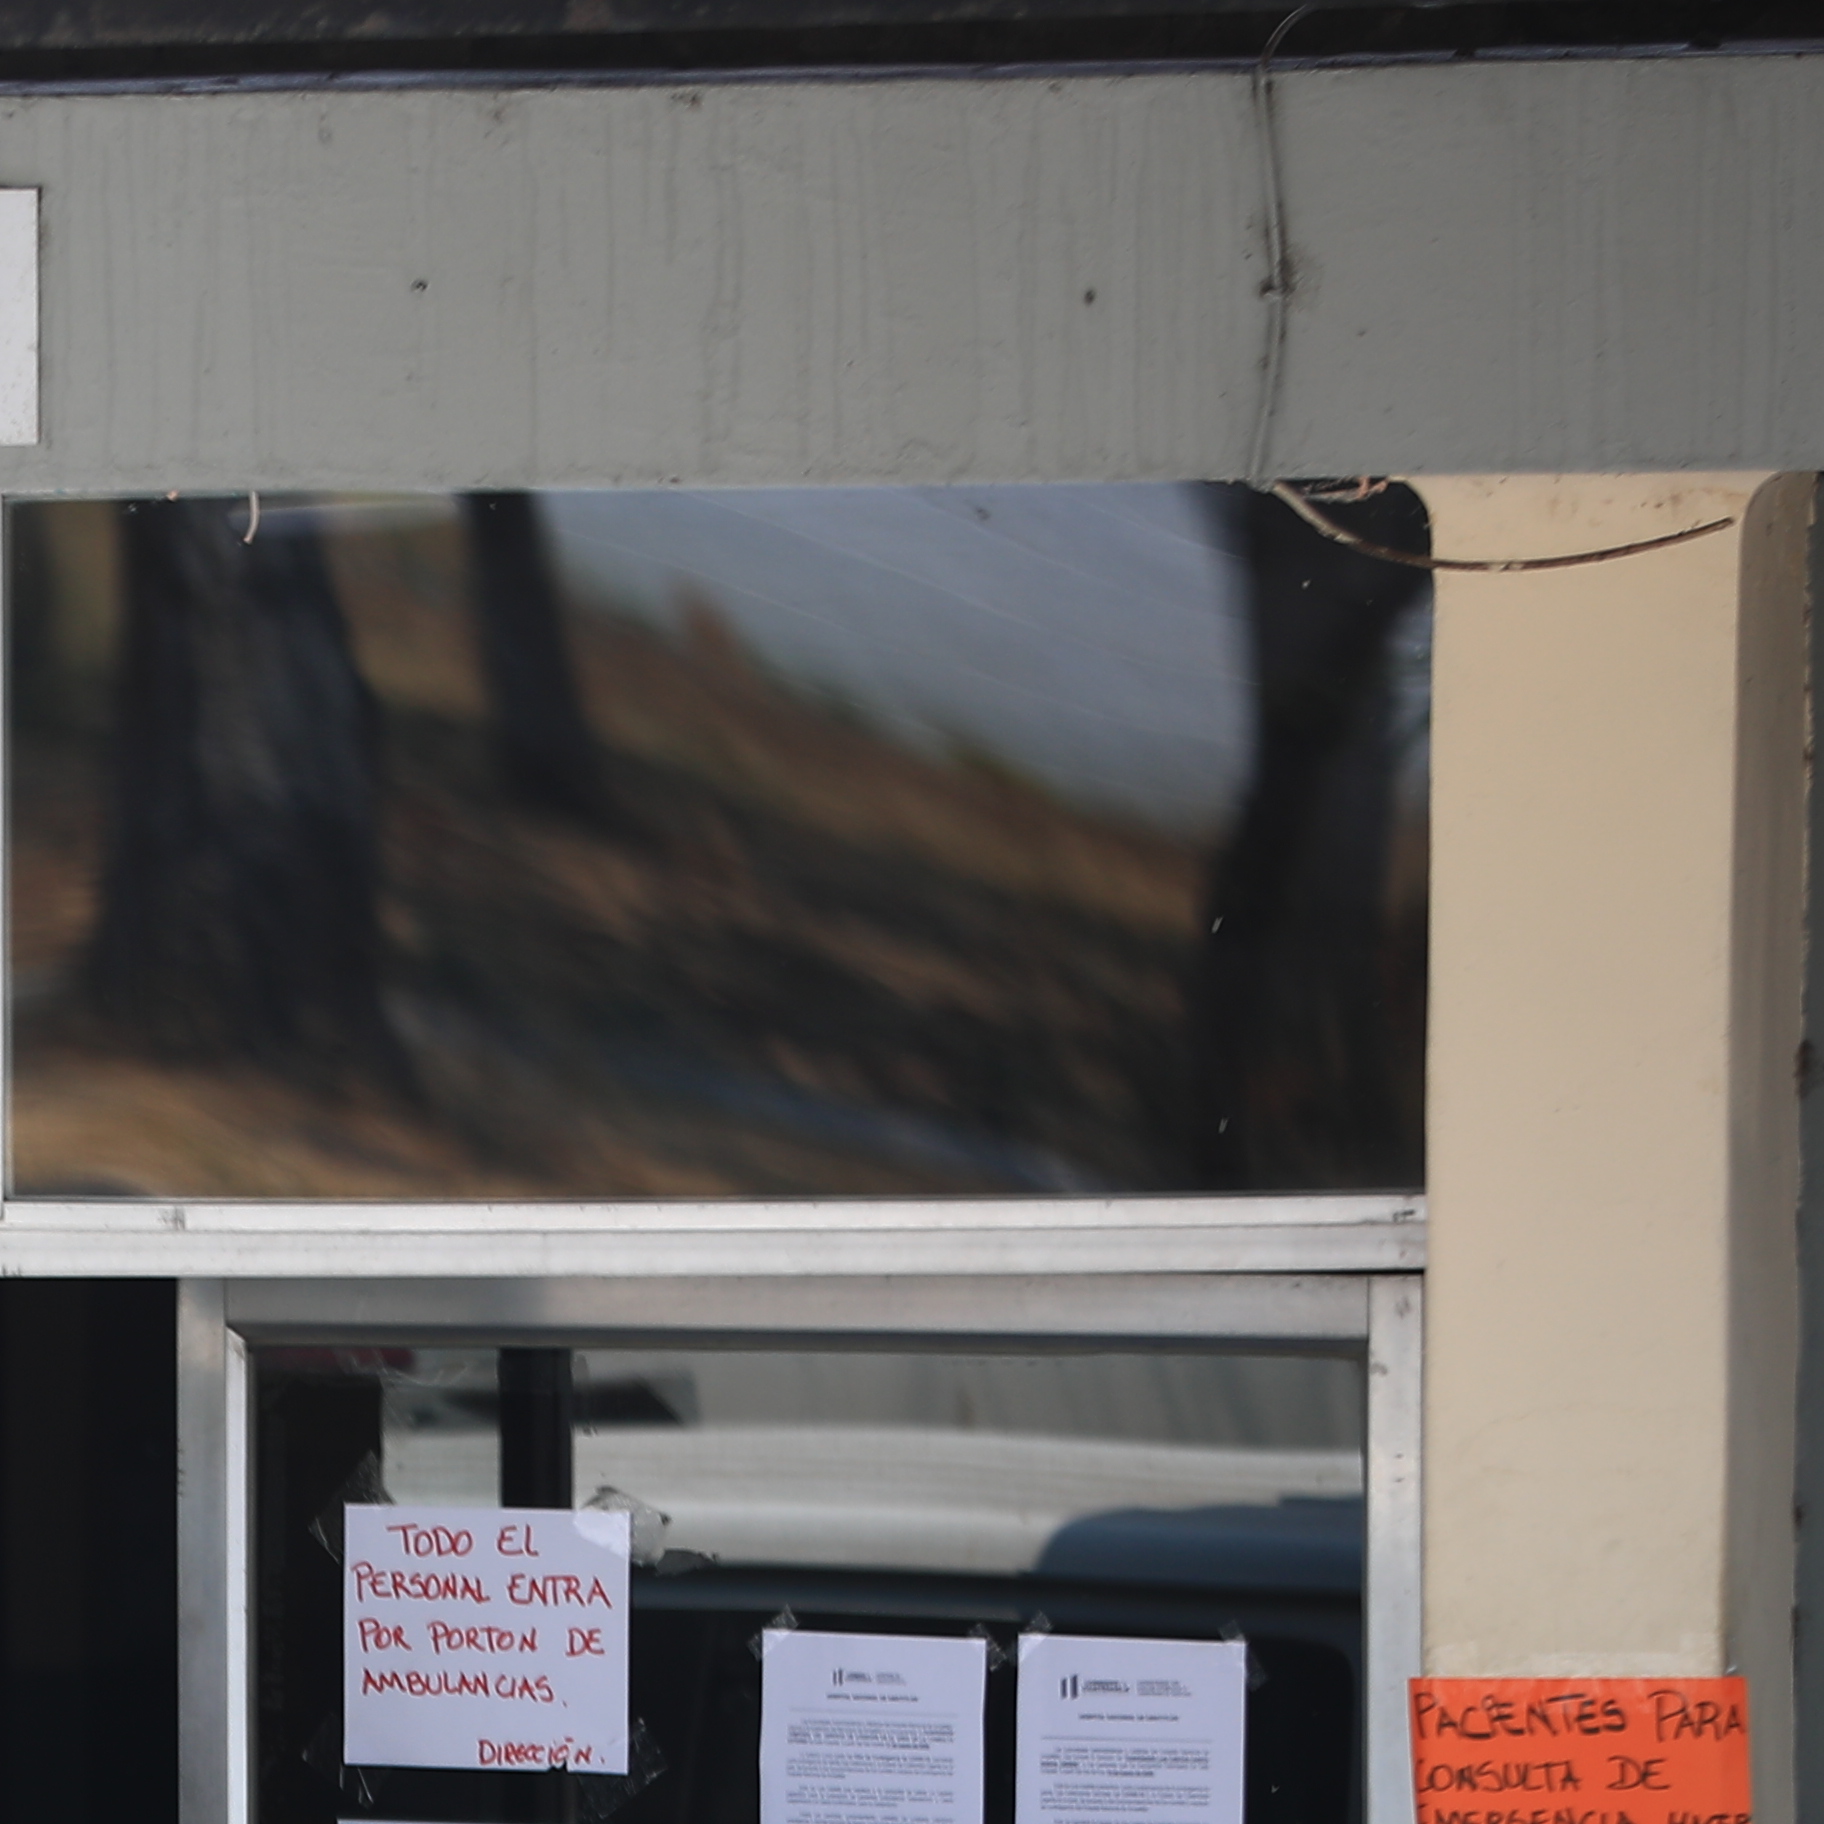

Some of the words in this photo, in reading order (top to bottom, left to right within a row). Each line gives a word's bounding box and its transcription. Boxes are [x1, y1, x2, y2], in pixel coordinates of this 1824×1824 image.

[387, 1522, 473, 1557] TODO
[496, 1524, 540, 1557] EL
[351, 1561, 491, 1604] PERSONAL
[507, 1574, 612, 1609] ENTRA
[358, 1617, 412, 1652] POR
[428, 1621, 537, 1654] PORTON
[565, 1628, 605, 1657] DE
[1648, 1689, 1746, 1742] PARA
[1416, 1758, 1581, 1792] CONSULTA
[1606, 1756, 1670, 1791] DE
